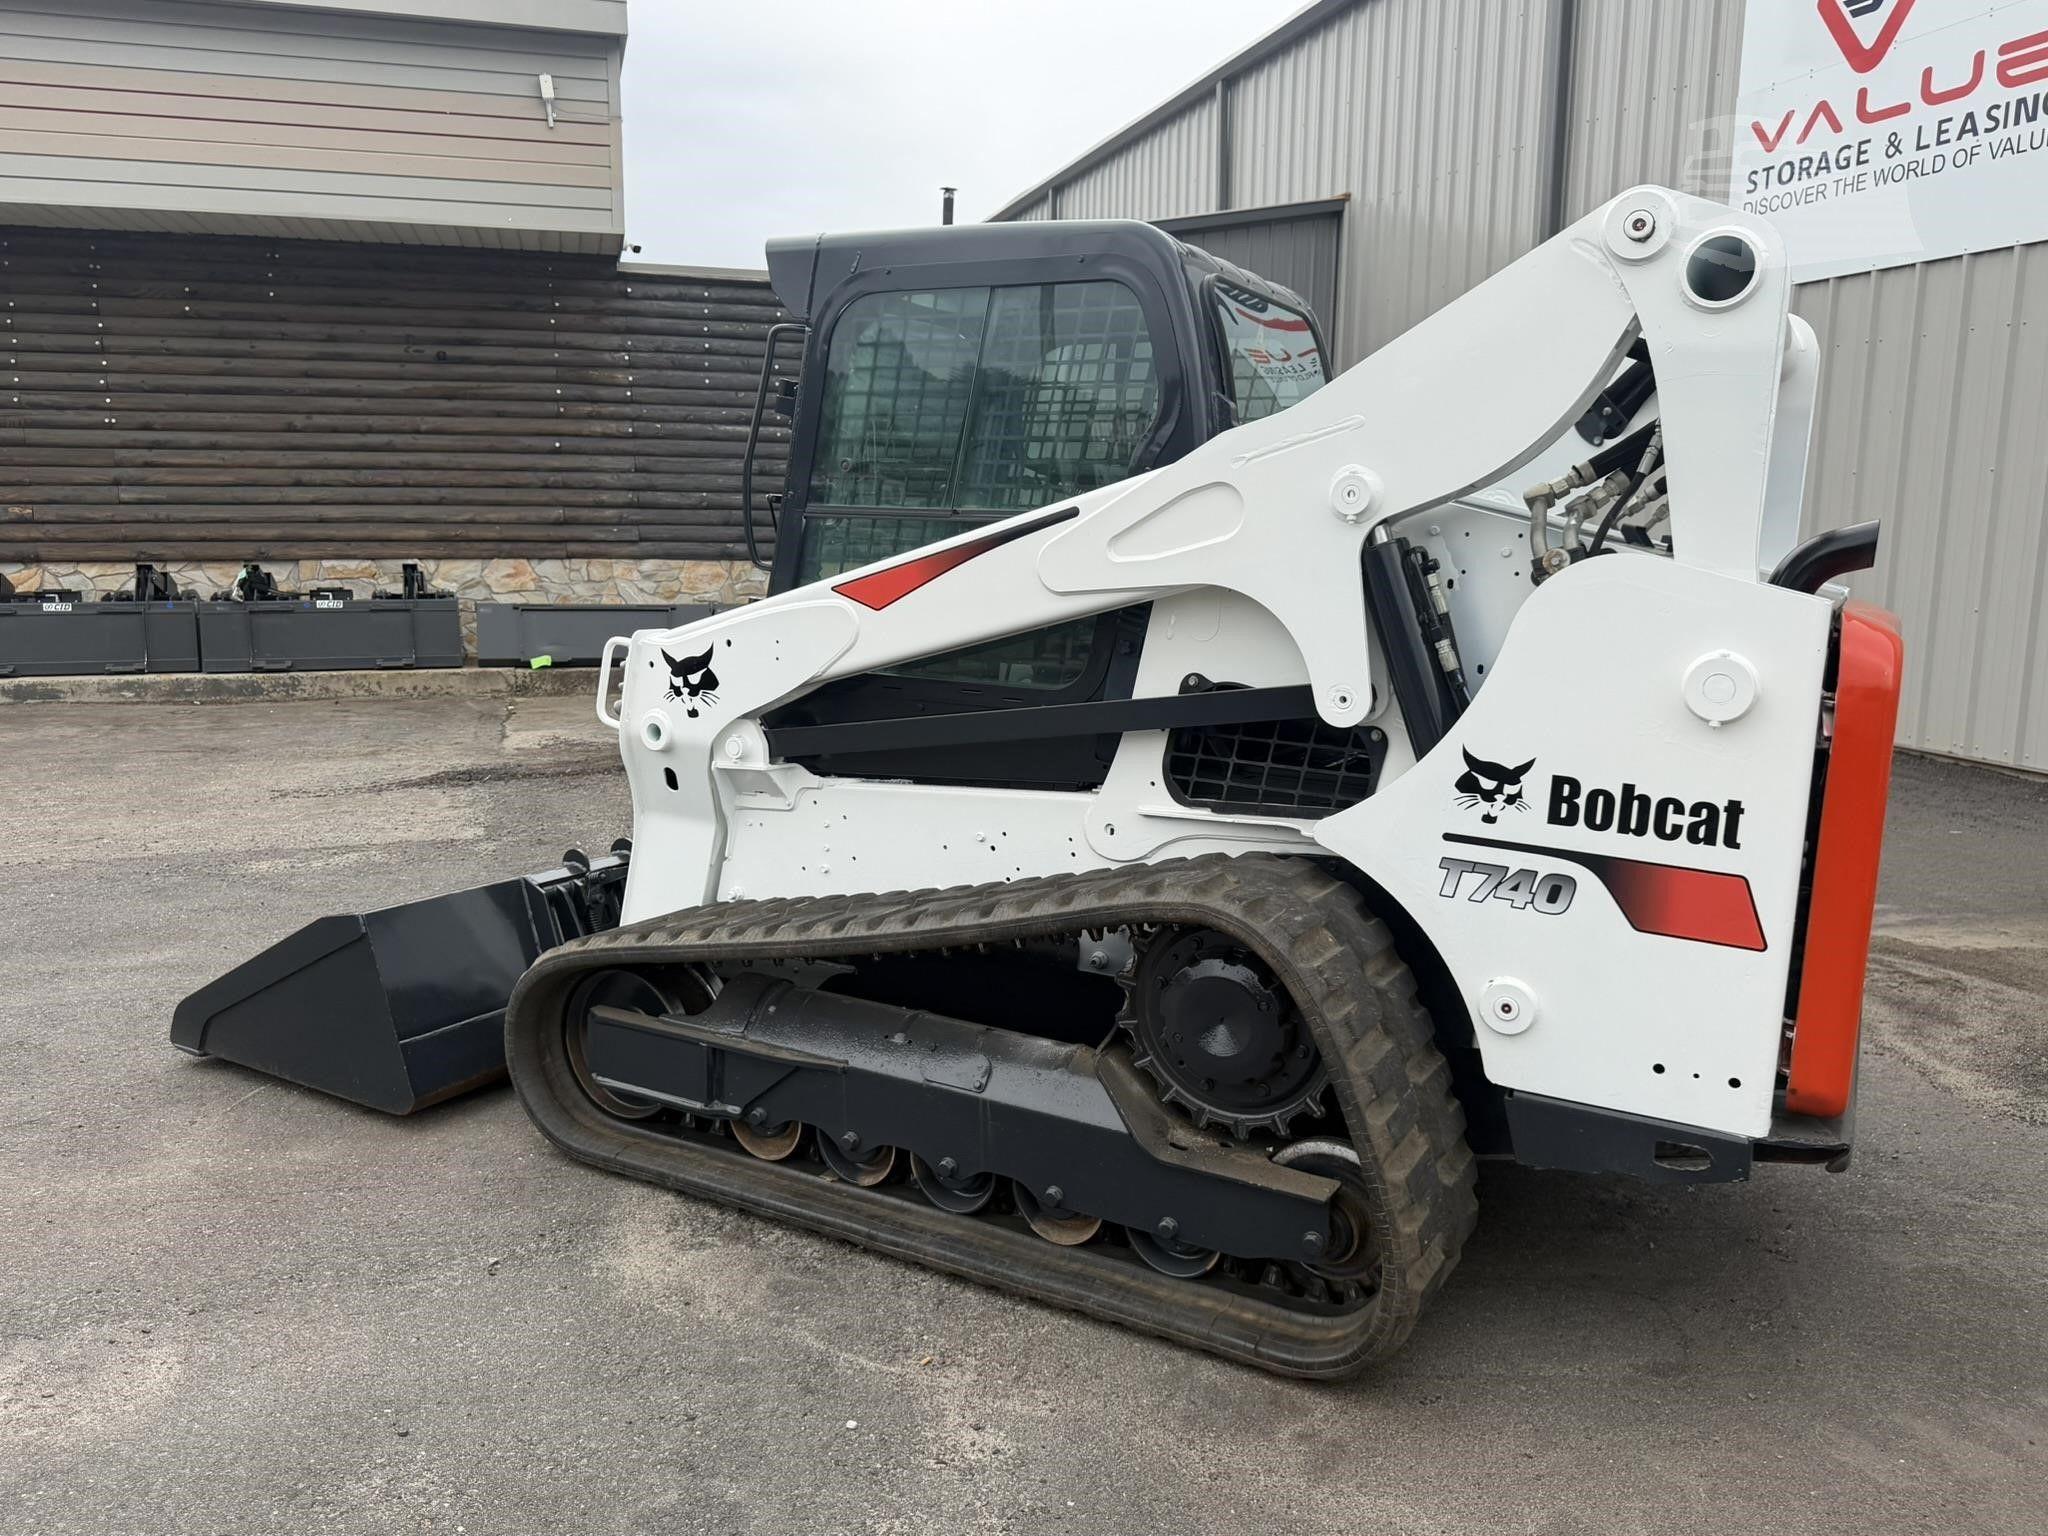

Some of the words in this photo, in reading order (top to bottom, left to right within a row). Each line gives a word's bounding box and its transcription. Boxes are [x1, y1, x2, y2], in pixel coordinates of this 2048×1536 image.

[1743, 182, 1828, 215] DISCOVER
[1833, 172, 1868, 197] THE
[1873, 153, 1946, 187] WORLD
[1952, 144, 1982, 169] OF
[1989, 128, 2048, 160] VALU
[1746, 138, 1872, 194] STORAGE
[1885, 131, 1903, 159] &
[1546, 774, 1745, 849] Bobcat
[1438, 856, 1577, 916] T740
